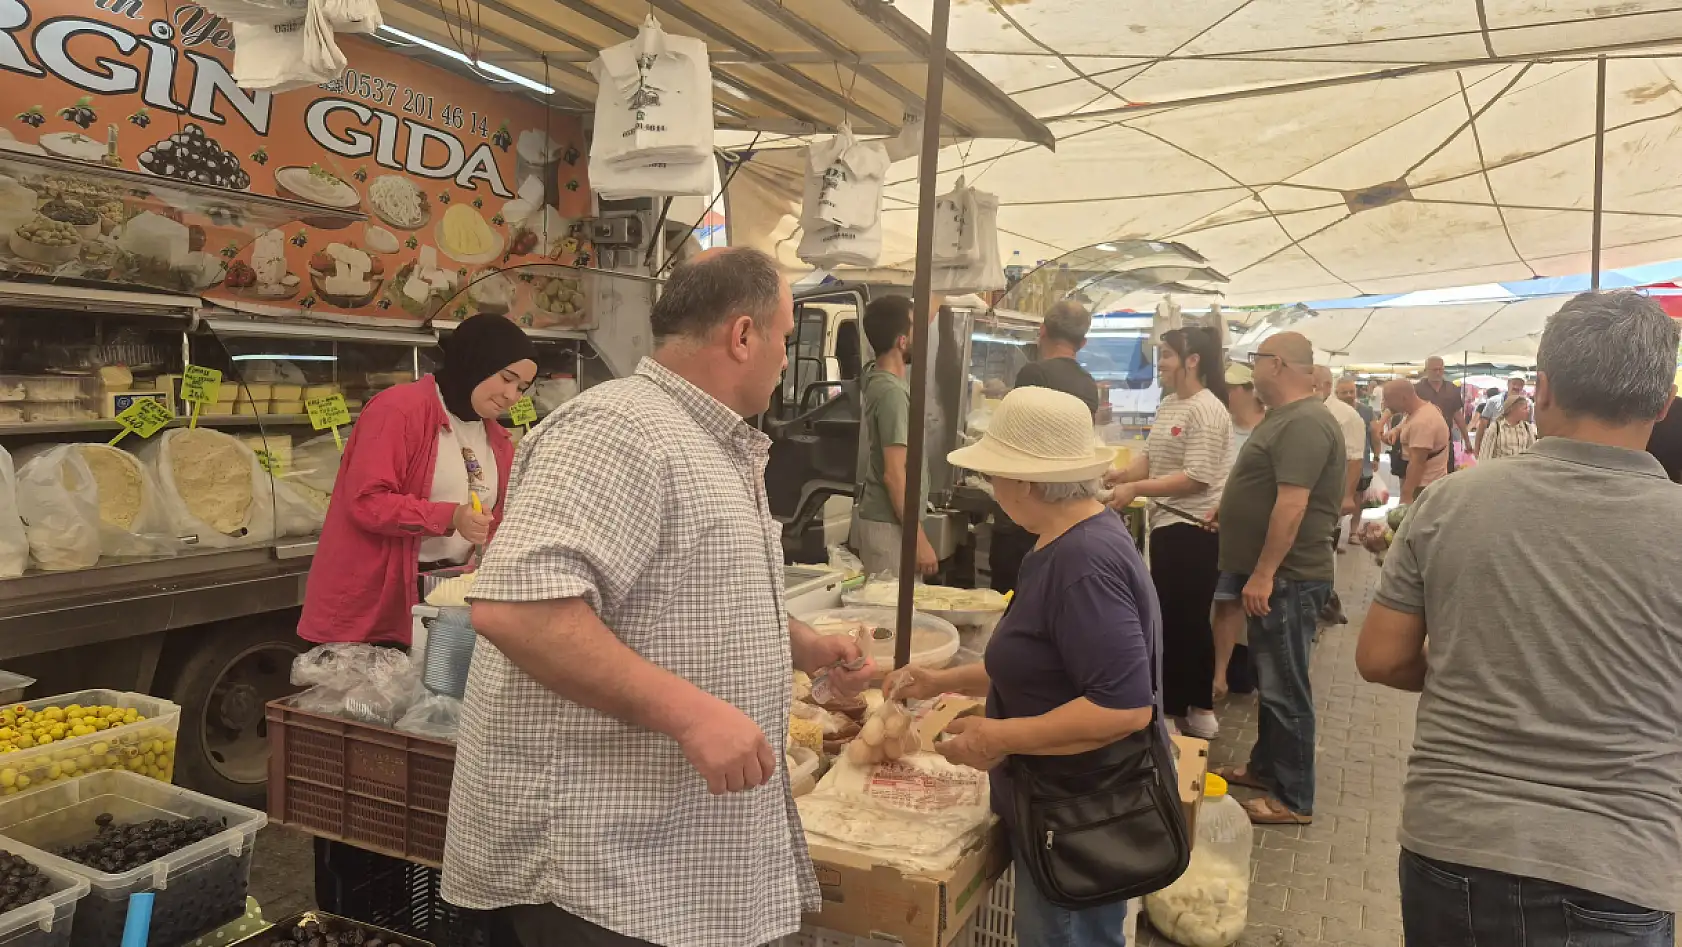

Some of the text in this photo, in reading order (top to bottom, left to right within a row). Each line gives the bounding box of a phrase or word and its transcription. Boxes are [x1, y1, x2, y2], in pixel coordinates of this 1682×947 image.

[173, 4, 236, 51] Ye
[344, 69, 488, 138] 0537 201 46 14
[304, 97, 515, 199] GIDA
